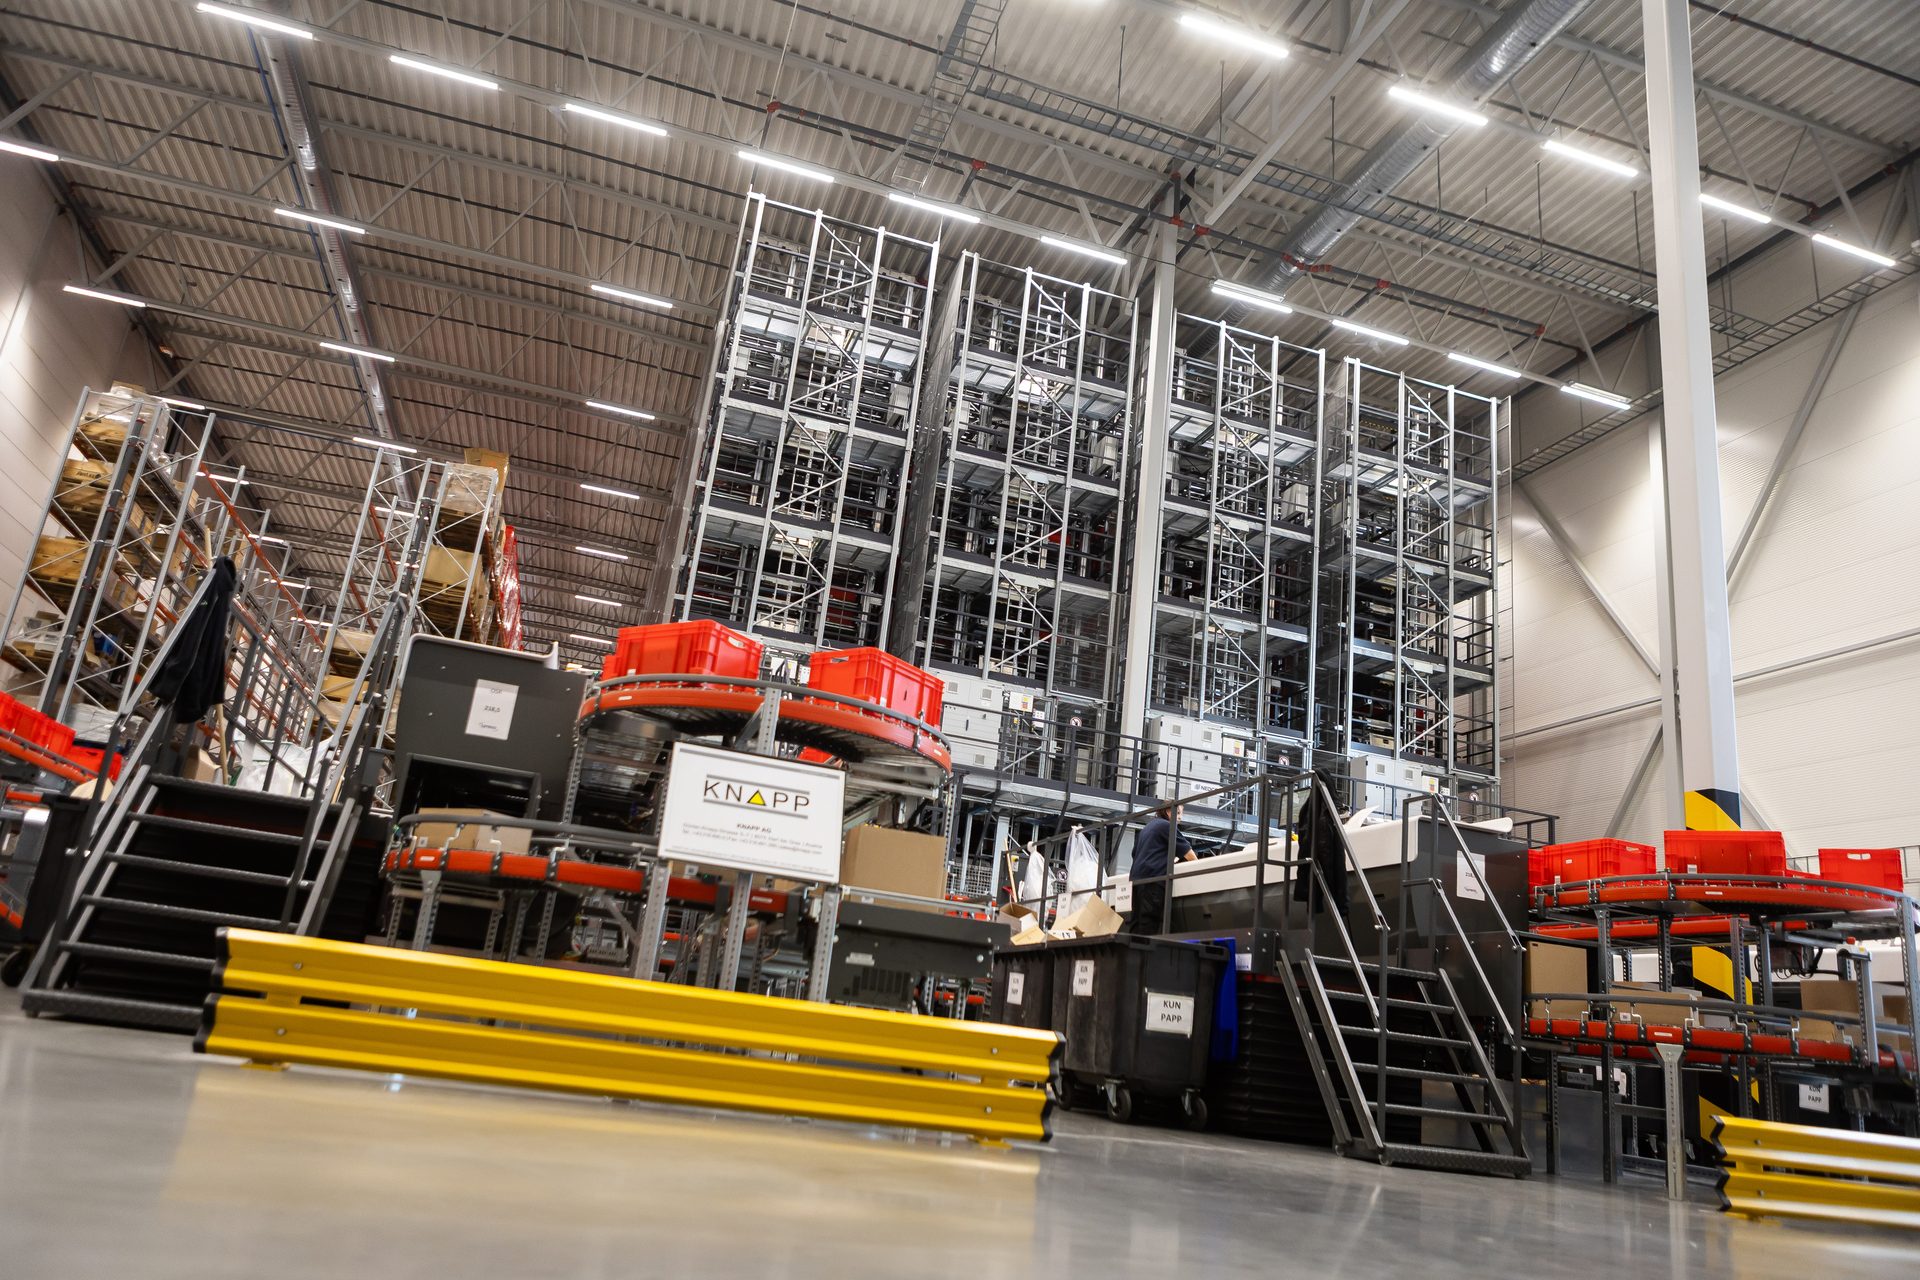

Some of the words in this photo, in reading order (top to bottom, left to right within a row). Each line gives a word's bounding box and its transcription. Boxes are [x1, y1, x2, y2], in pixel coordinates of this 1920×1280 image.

[703, 779, 810, 812] KNAPP
[1163, 999, 1182, 1010] KUN
[1160, 1013, 1182, 1023] PAPP
[1808, 1095, 1821, 1103] PAPP
